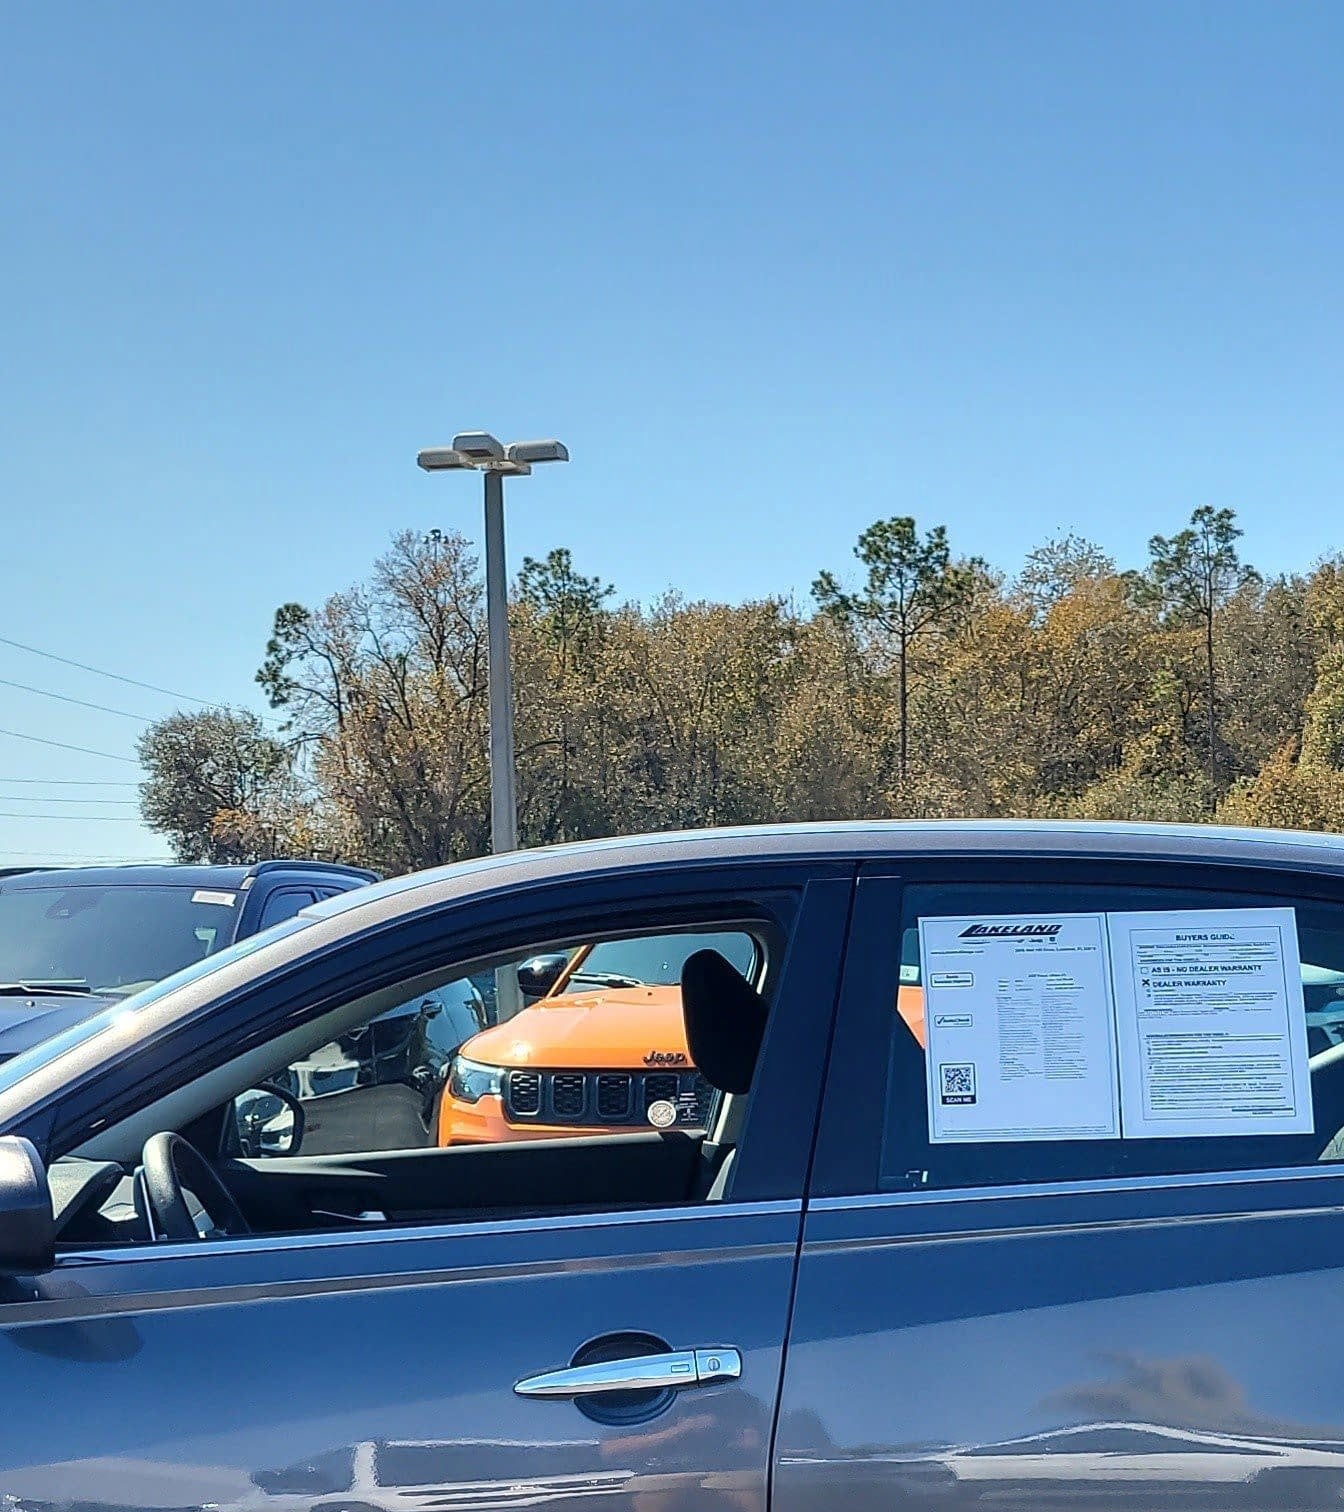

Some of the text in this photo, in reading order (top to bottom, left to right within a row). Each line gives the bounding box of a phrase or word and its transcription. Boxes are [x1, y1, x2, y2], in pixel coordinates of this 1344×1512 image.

[958, 924, 1063, 937] LAKELAND
[1189, 965, 1219, 973] DEALER
[1220, 964, 1262, 972] WARRANTY
[1152, 979, 1227, 988] DEALER WARRANTY
[643, 1050, 687, 1065] Jeep
